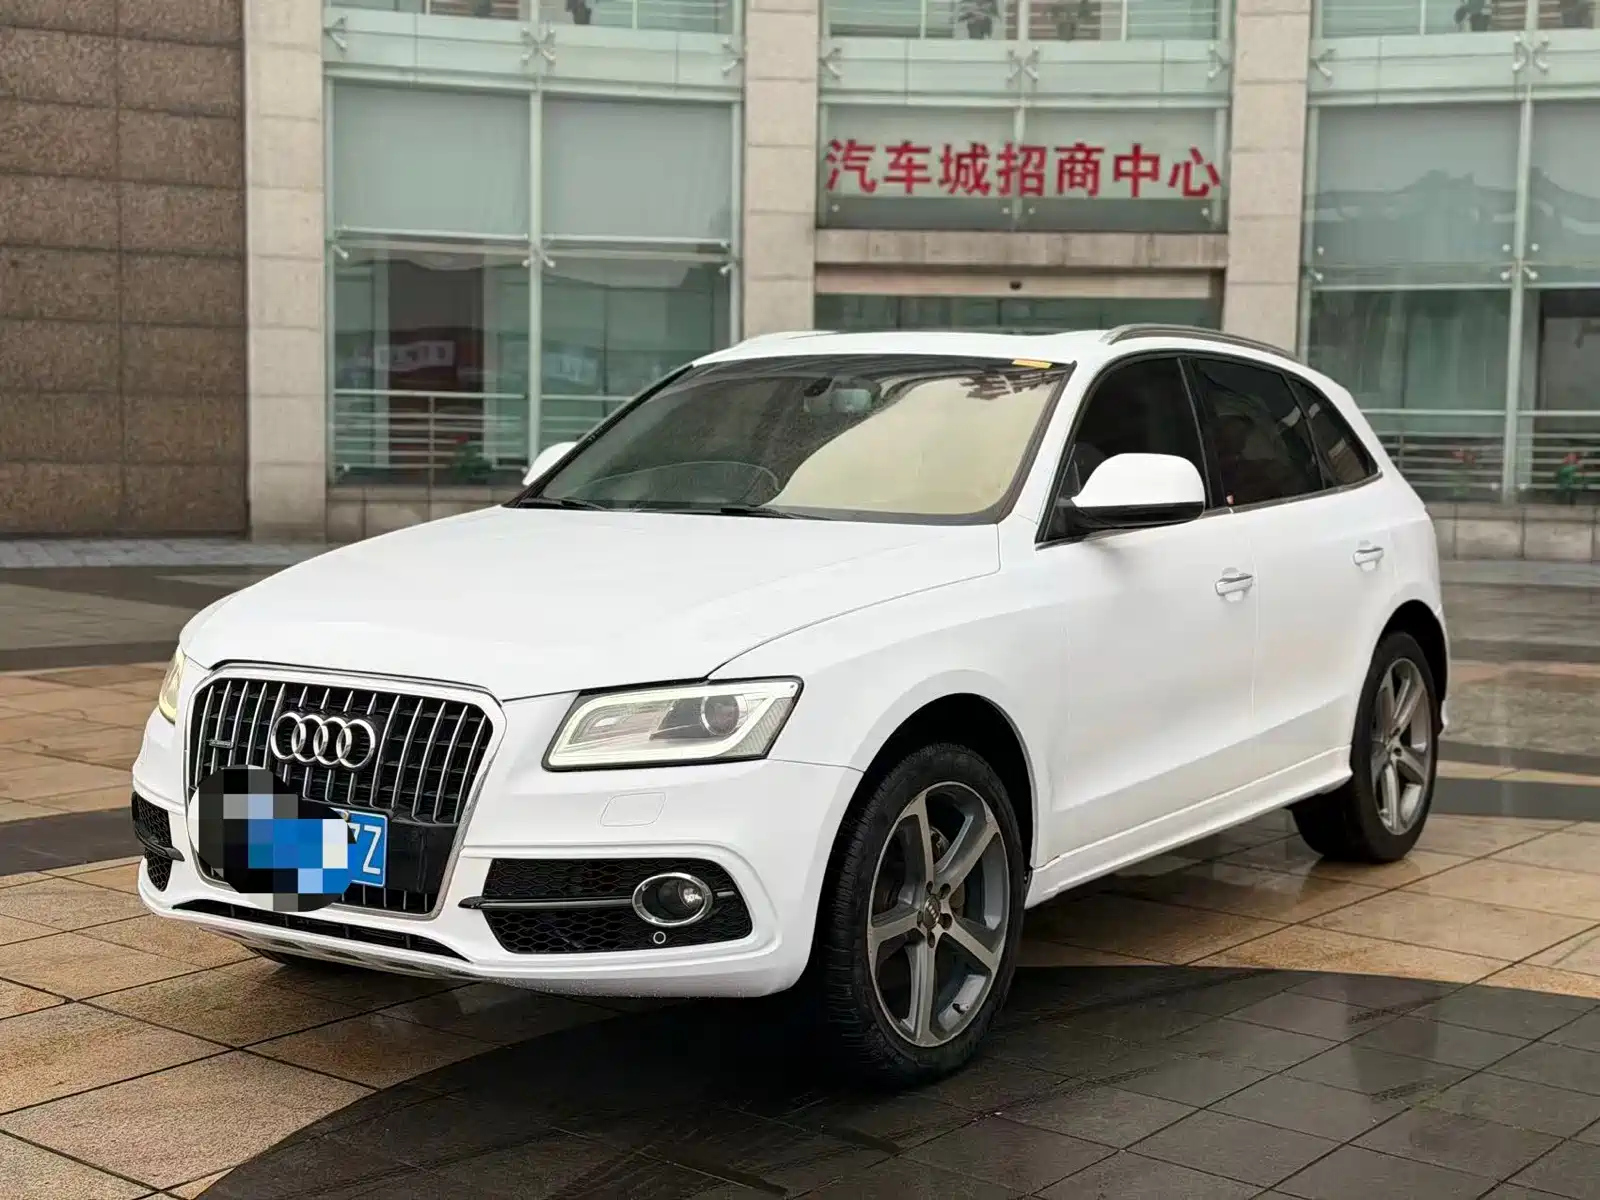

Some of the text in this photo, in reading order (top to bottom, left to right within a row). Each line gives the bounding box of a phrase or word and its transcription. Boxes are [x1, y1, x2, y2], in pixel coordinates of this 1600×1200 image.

[826, 139, 1221, 198] 汽车城招商中心
